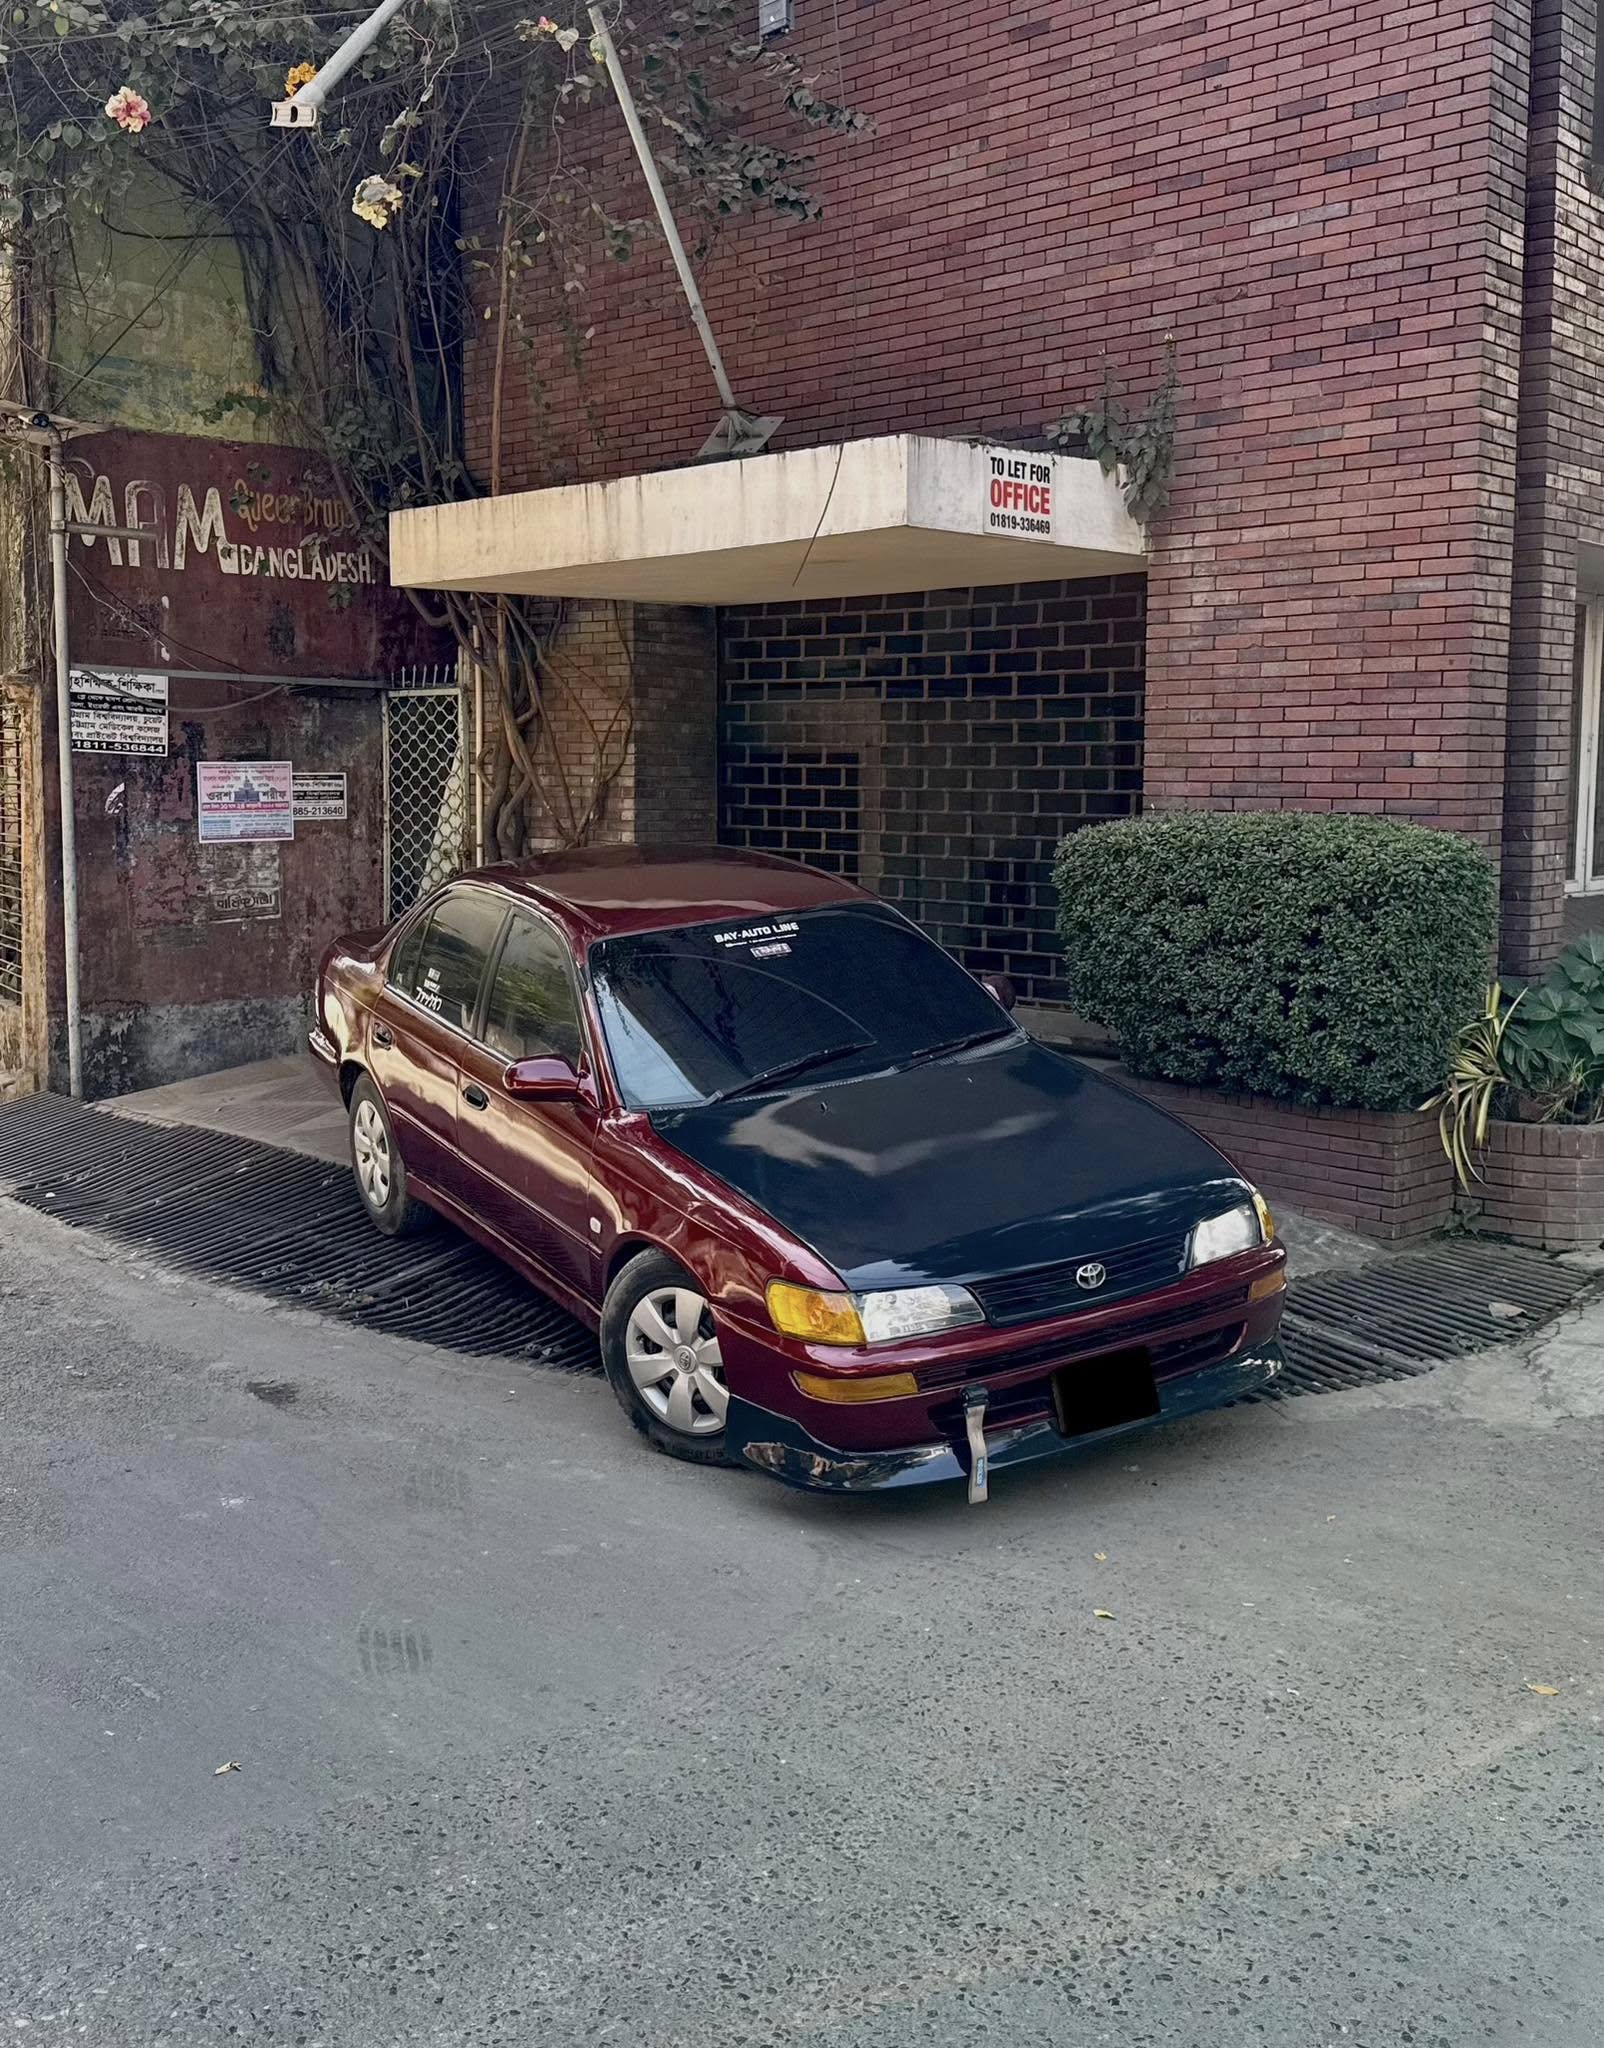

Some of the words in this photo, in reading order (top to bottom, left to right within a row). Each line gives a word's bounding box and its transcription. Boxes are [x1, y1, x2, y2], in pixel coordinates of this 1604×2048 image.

[990, 456, 1004, 475] TO
[1008, 460, 1027, 479] LET
[1030, 463, 1050, 483] FOR
[990, 478, 1050, 515] OFFICE
[990, 513, 1050, 534] 01819-336469
[72, 740, 164, 753] 1811-536844
[714, 926, 771, 943] BAY-AUTO
[772, 922, 799, 933] LINE
